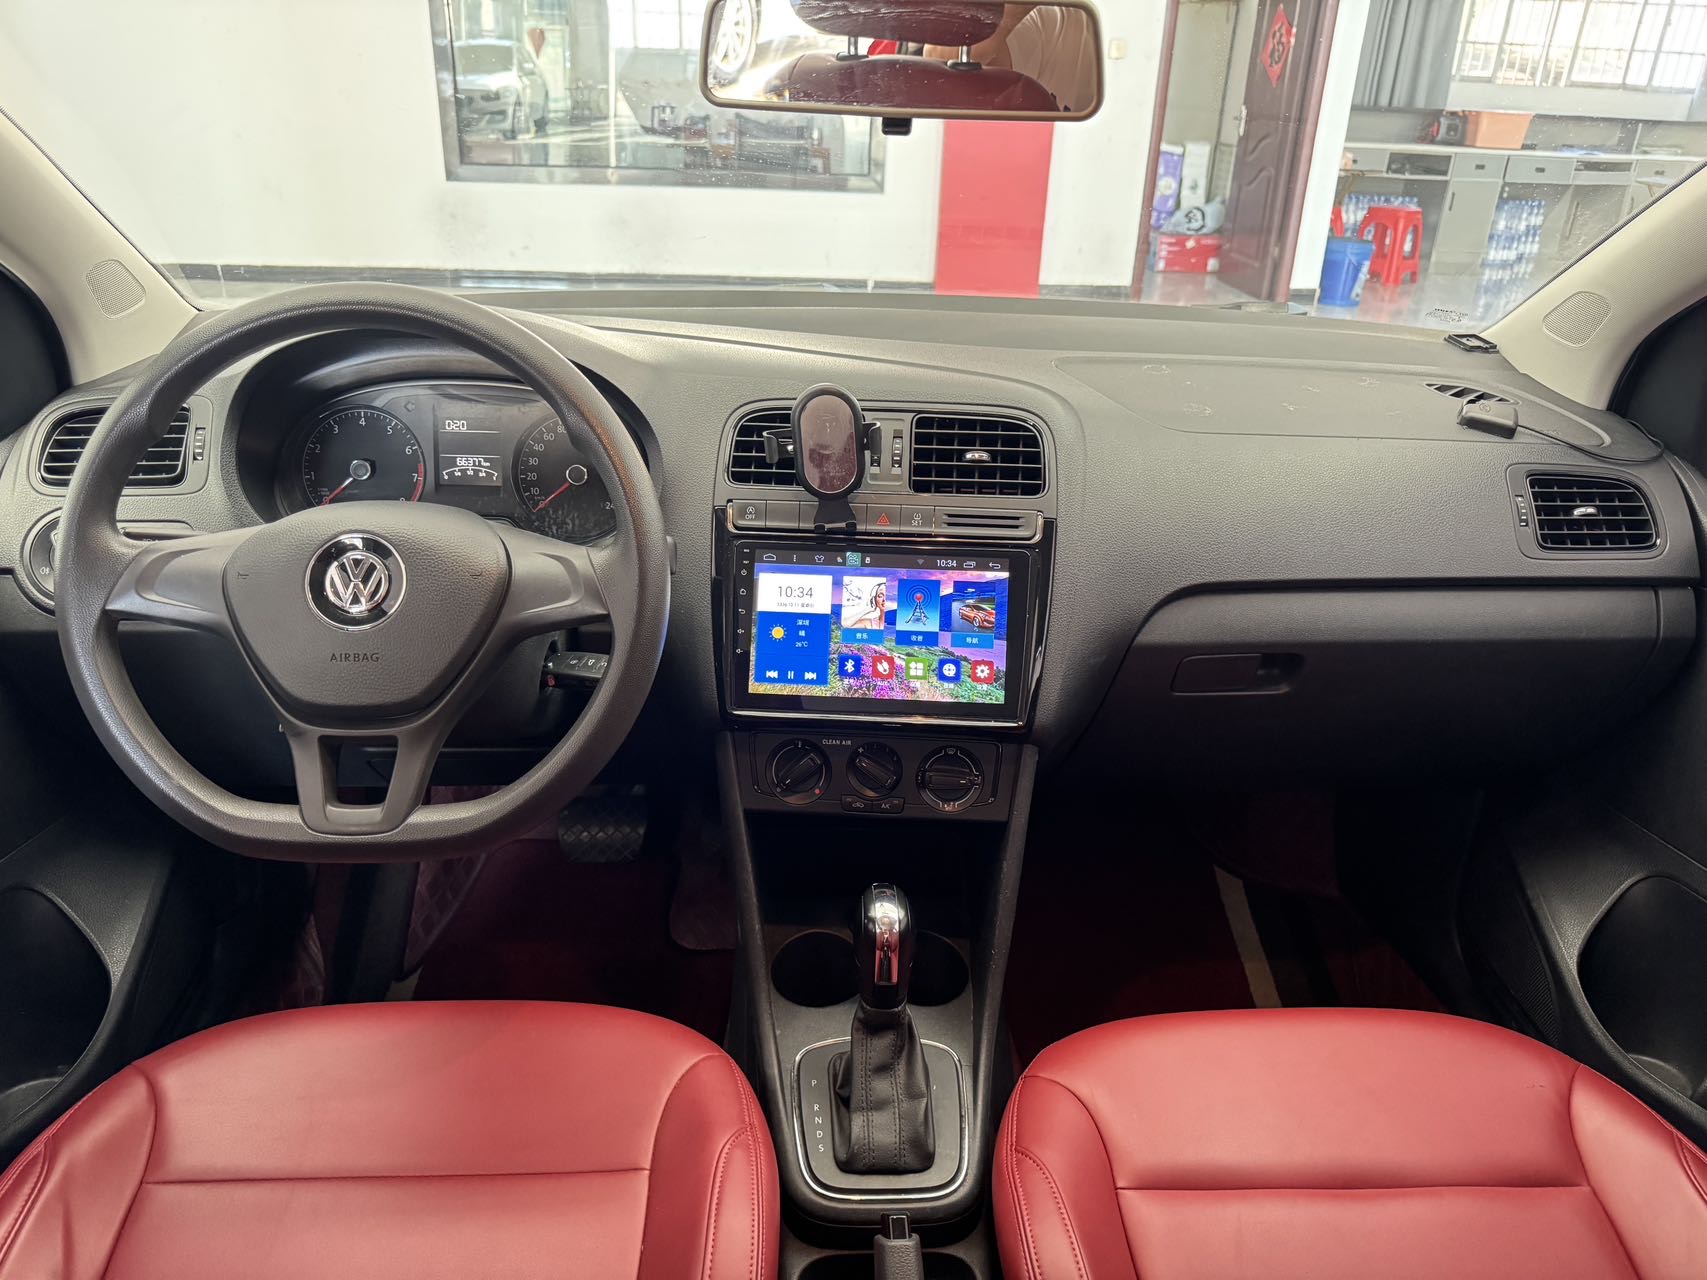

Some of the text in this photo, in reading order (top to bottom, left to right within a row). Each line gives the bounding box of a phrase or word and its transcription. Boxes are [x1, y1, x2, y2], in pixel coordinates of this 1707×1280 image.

[359, 417, 366, 426] 4
[333, 425, 339, 434] 3
[387, 425, 393, 435] 5
[543, 432, 555, 441] 60
[315, 443, 321, 453] 2
[405, 445, 412, 455] 6
[533, 443, 545, 452] 40
[528, 457, 539, 466] 30
[411, 473, 418, 482] 7
[530, 487, 540, 495] 10
[936, 559, 957, 568] 10:34
[778, 586, 814, 599] 10:34
[330, 652, 381, 663] AIRBAG
[816, 1130, 823, 1138] D
[818, 1144, 824, 1152] S
